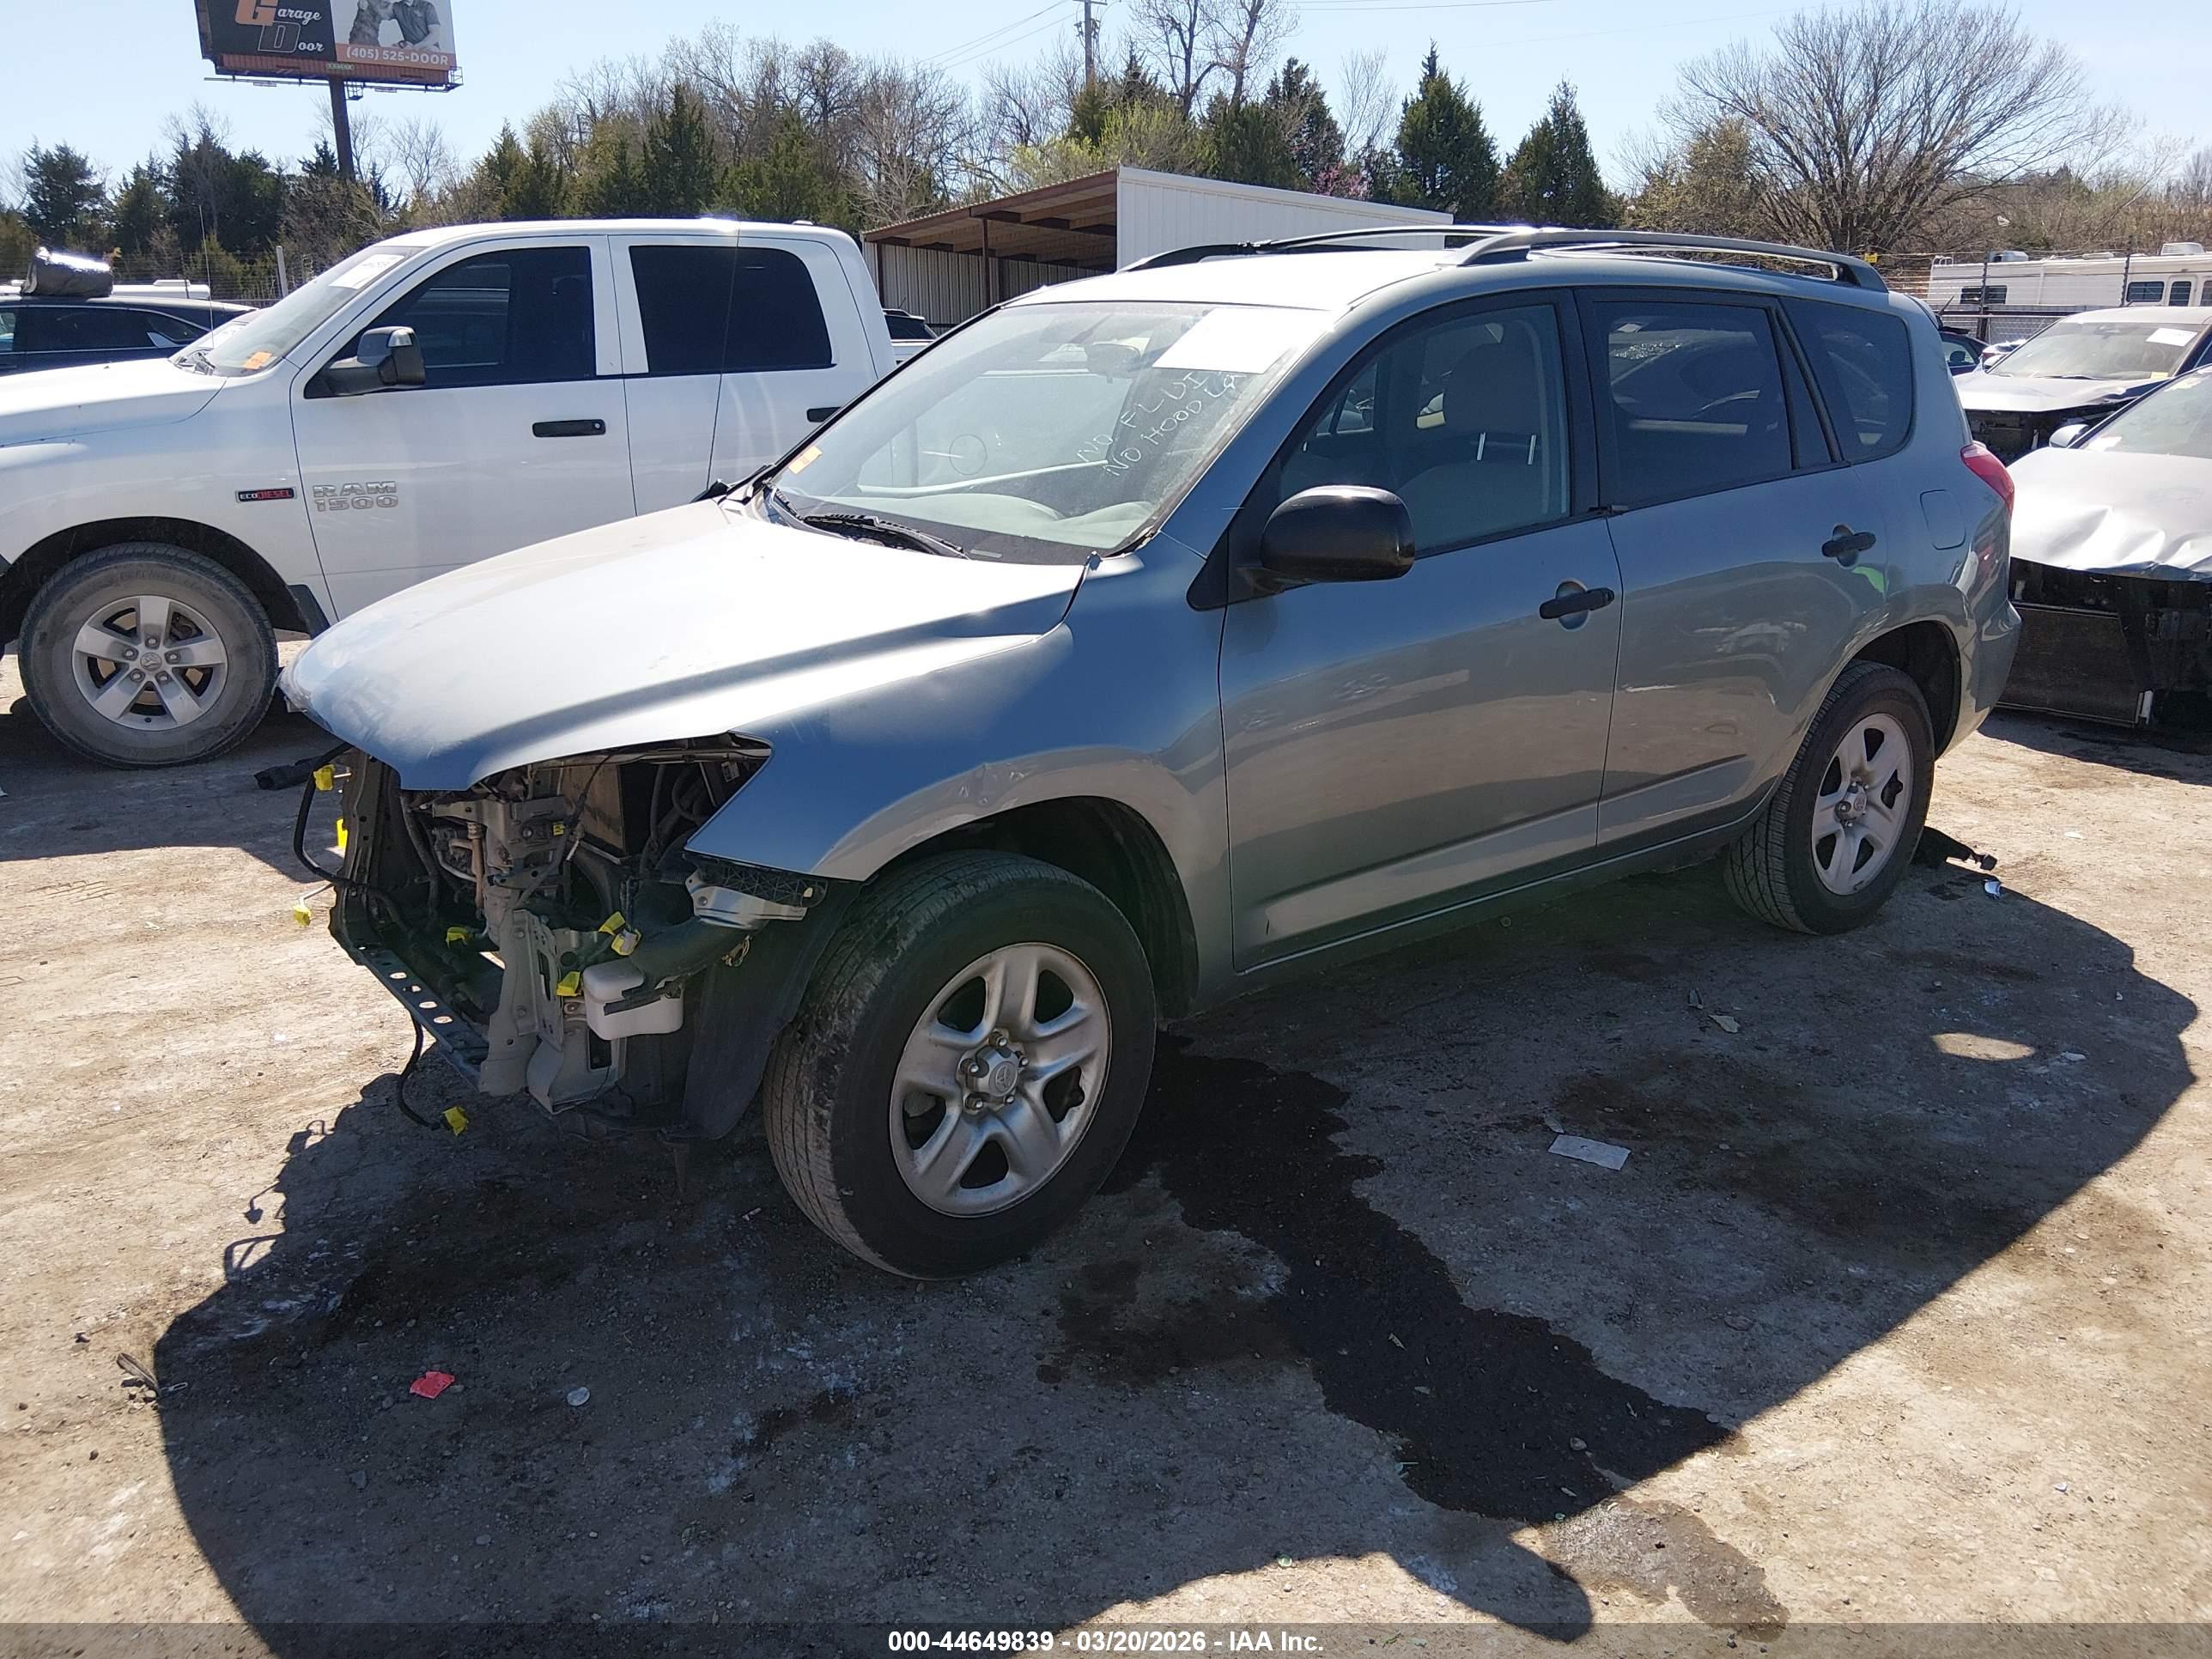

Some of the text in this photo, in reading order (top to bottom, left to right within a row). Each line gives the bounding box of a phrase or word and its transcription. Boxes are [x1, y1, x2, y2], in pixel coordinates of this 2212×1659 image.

[346, 46, 448, 66] (405) 525-DOOR
[1077, 371, 1213, 462] NO FLUI
[1103, 447, 1141, 477] NO
[1140, 400, 1202, 445] HOOD
[313, 481, 397, 498] RAM
[314, 495, 398, 512] 1500
